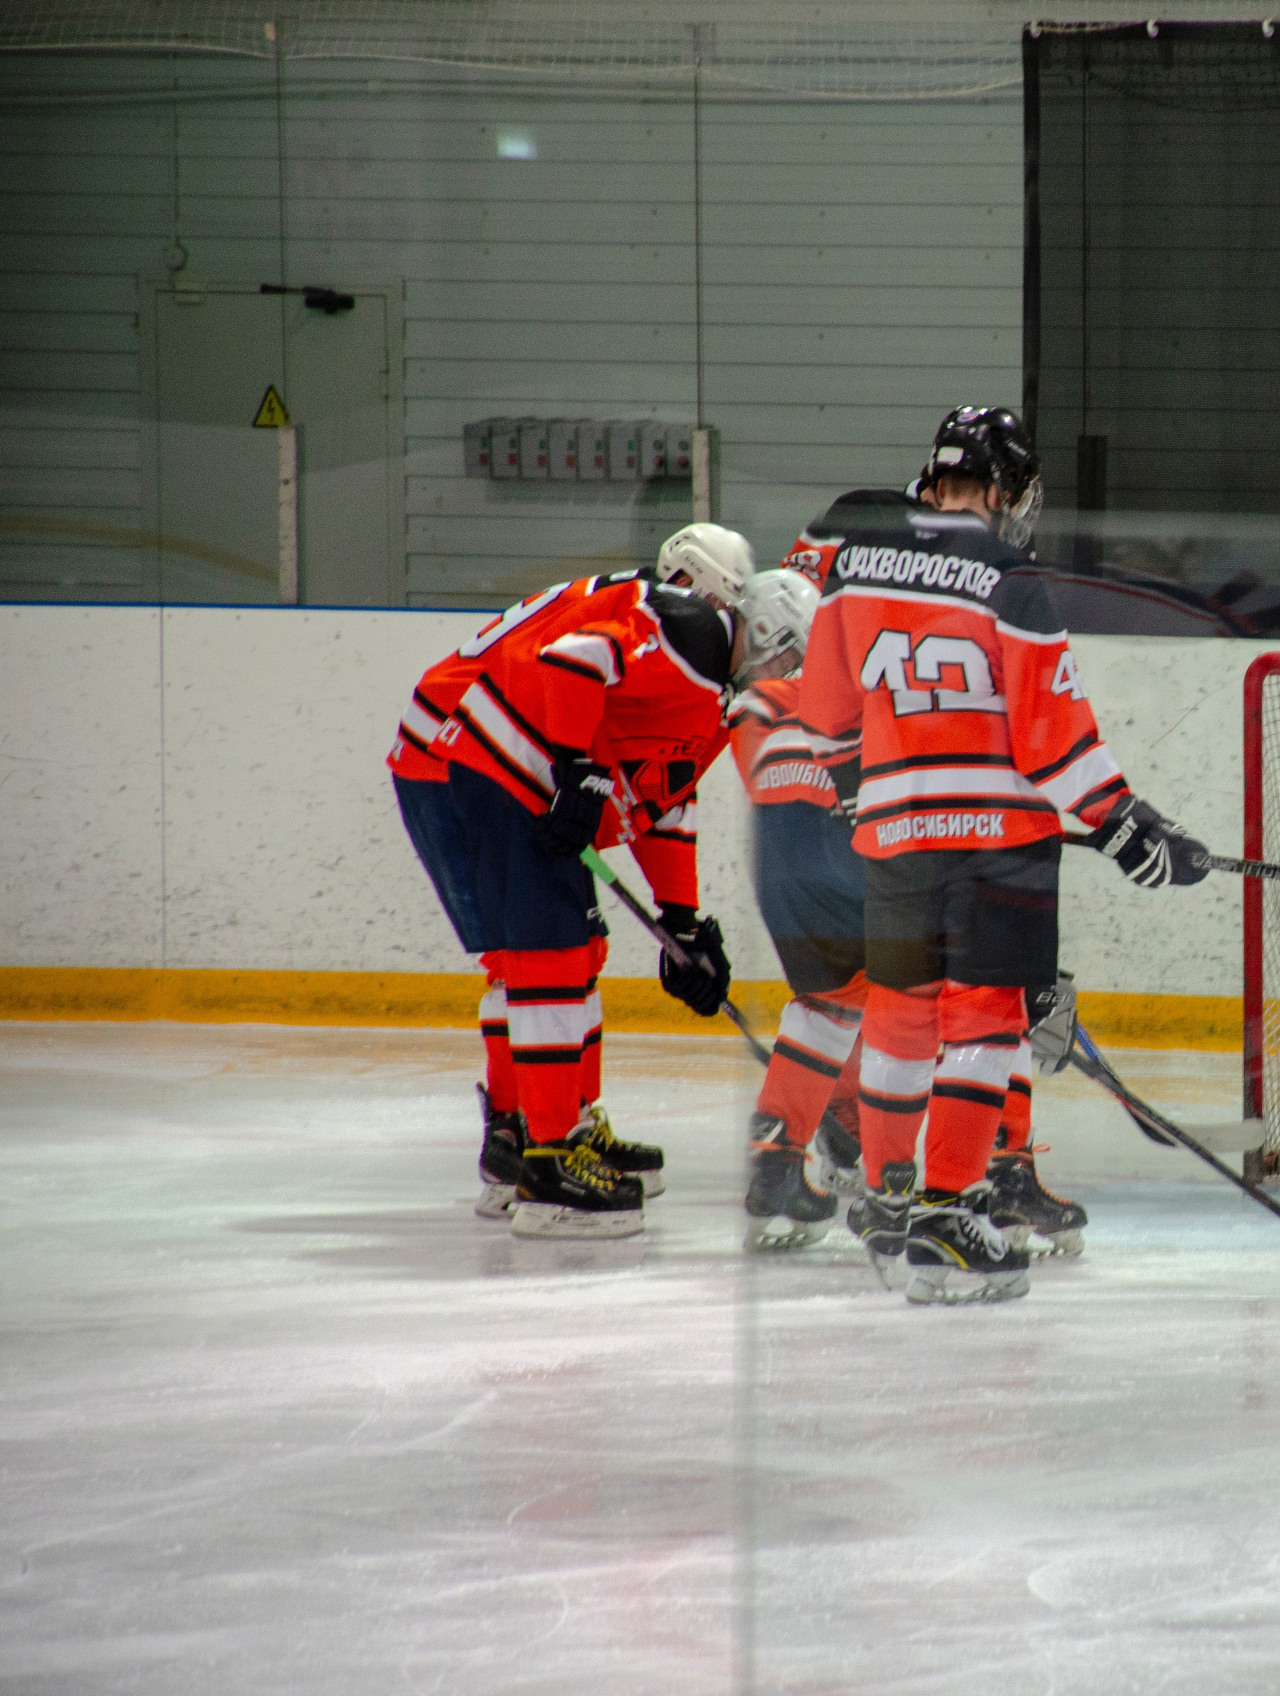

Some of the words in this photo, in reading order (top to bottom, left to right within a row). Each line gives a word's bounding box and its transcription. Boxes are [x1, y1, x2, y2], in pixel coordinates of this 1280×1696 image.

[860, 629, 1007, 718] 42
[1050, 649, 1089, 702] 4
[876, 813, 1004, 848] НОВОСИБИРСК
